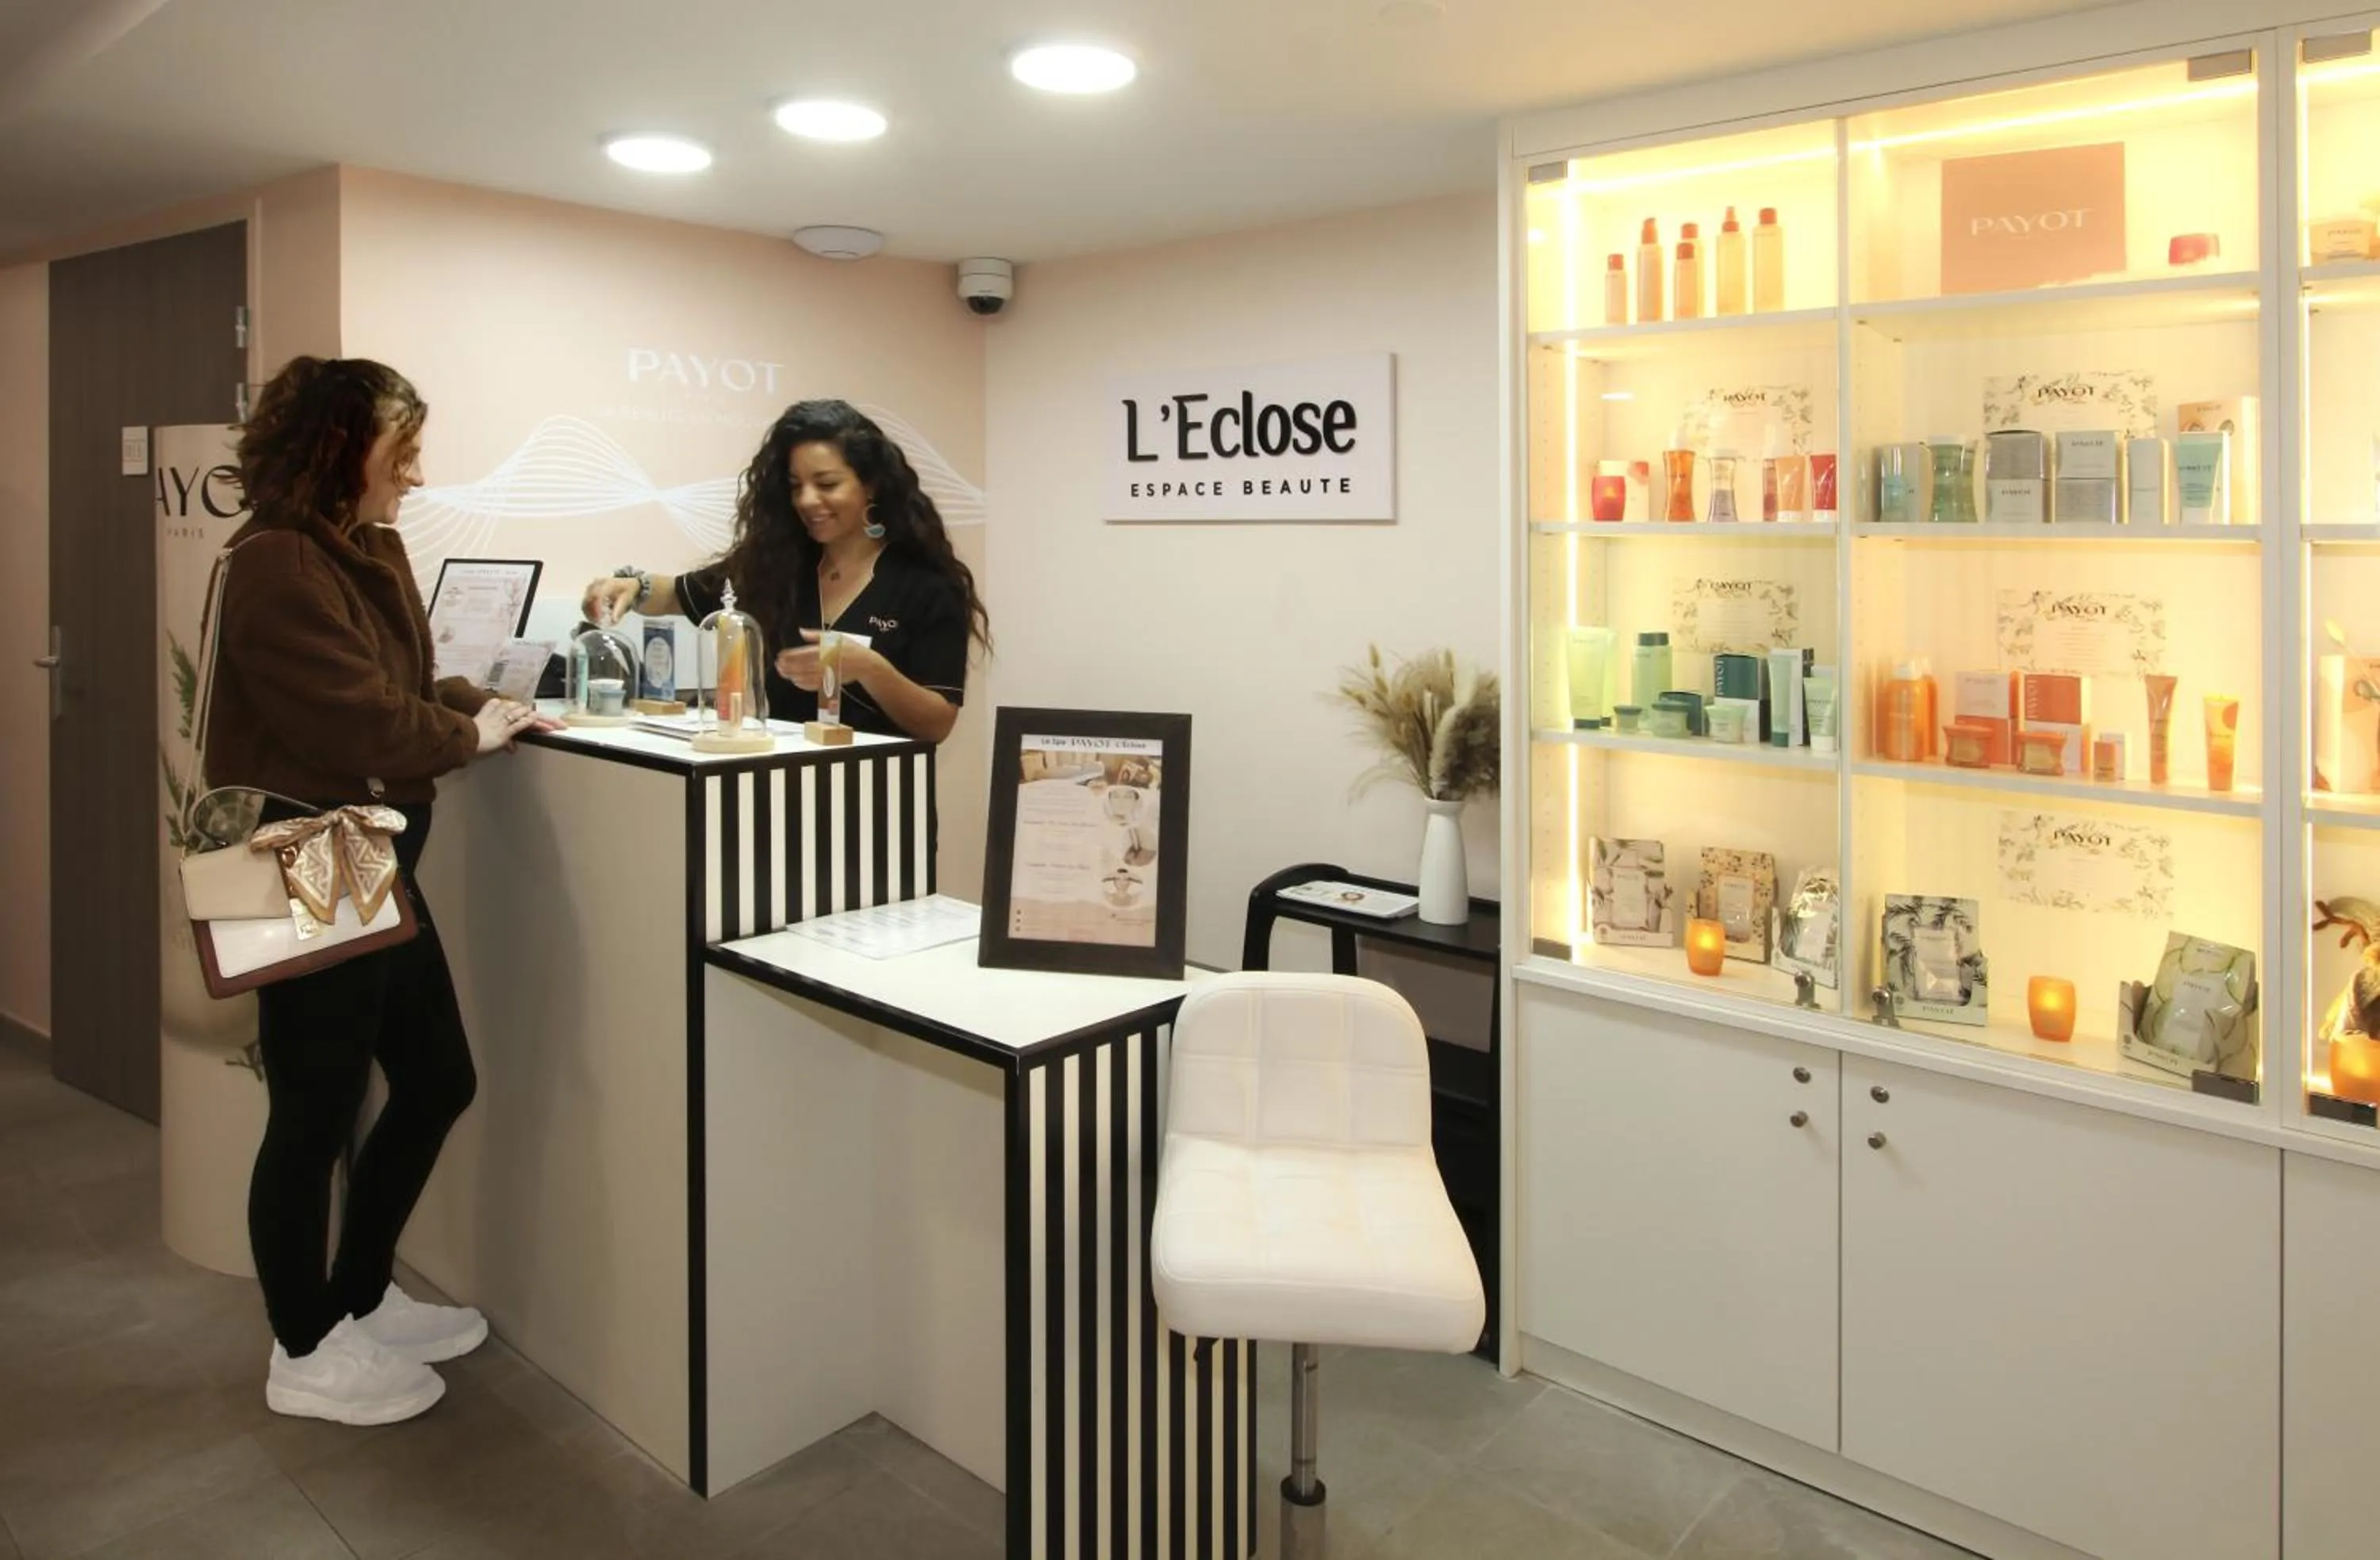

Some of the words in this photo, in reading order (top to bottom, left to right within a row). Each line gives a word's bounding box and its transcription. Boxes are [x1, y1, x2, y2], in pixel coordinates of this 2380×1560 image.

[1971, 207, 2095, 236] PAYOT
[627, 348, 786, 394] PAYOT
[2037, 386, 2094, 398] PAYOT
[1121, 390, 1357, 463] L'Eclose
[1130, 481, 1223, 498] ESPACE
[1242, 478, 1351, 495] BEAUTE
